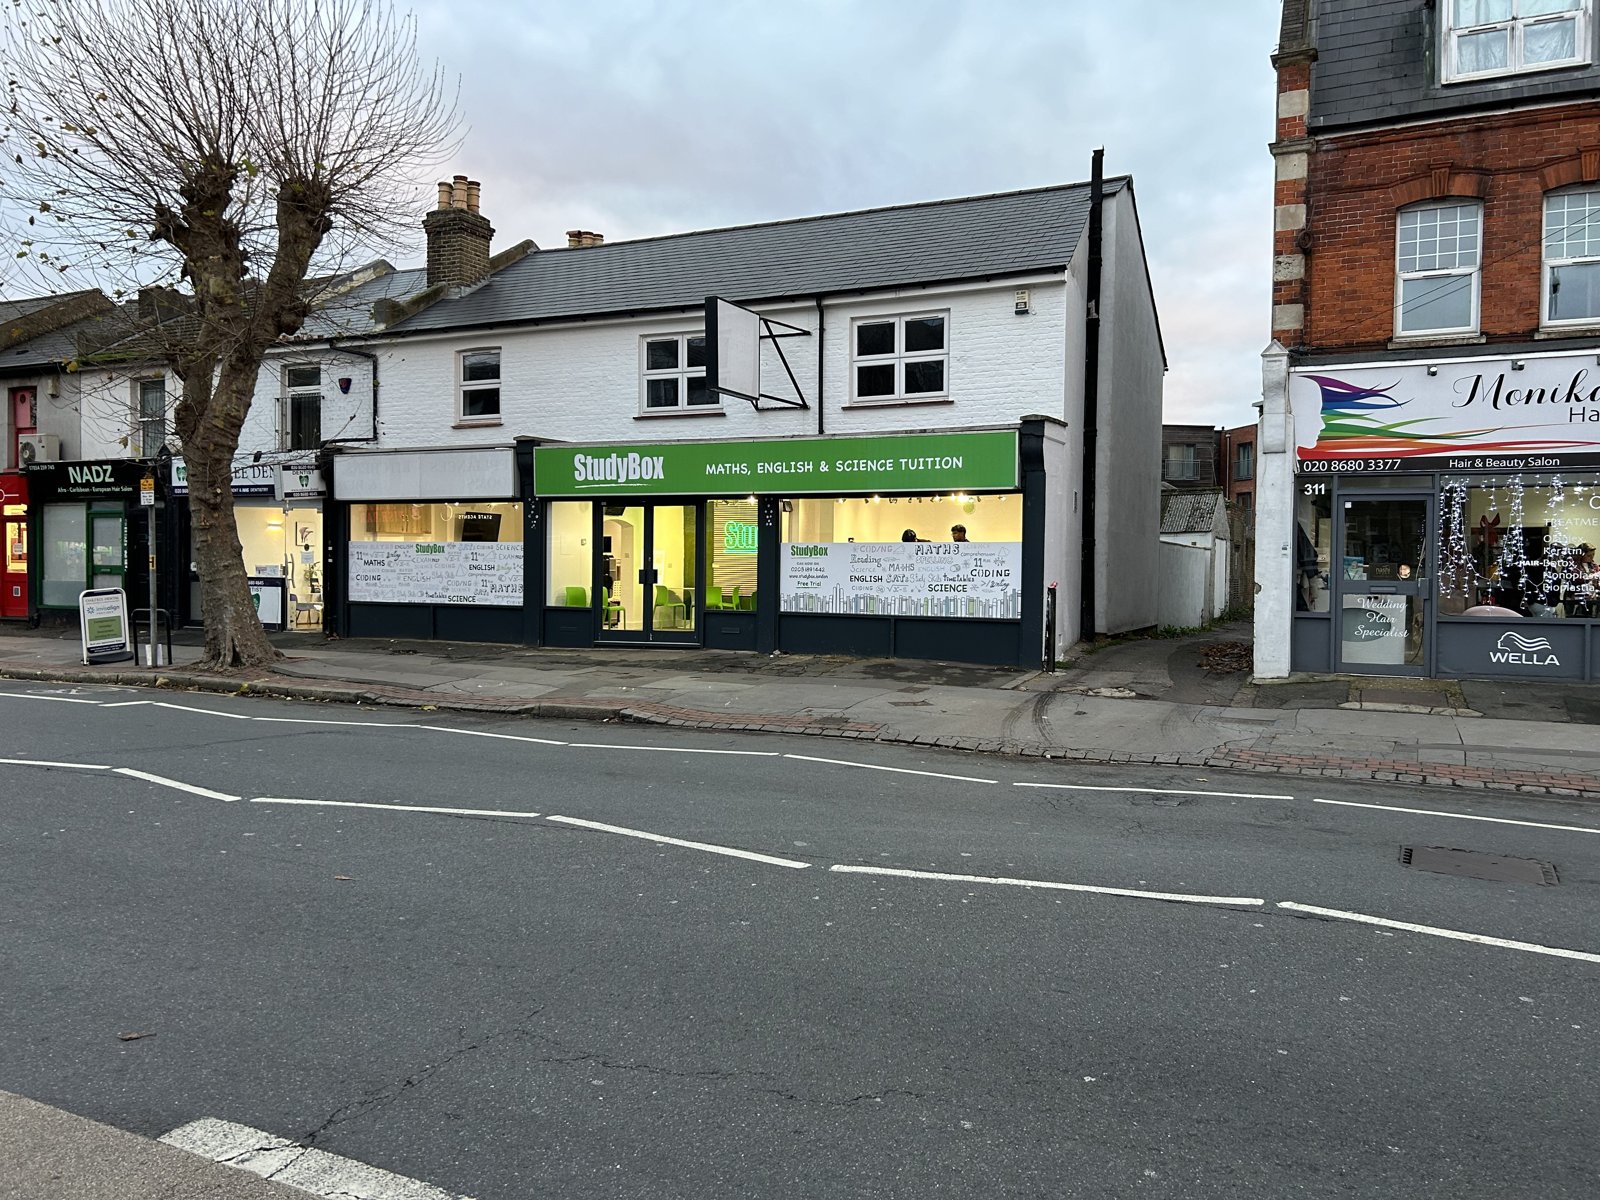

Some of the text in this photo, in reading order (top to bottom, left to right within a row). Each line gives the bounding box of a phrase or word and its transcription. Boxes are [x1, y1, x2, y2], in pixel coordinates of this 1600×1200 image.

[574, 452, 664, 482] StudyBox
[706, 456, 963, 475] MATHS, ENGLISH & SCIENCE TUITION
[1303, 459, 1401, 472] 020 8680 3377
[1450, 457, 1560, 469] Hair & Beauty Salon
[68, 465, 115, 484] NADZ
[1304, 483, 1325, 495] 311
[416, 544, 445, 555] StudyBox
[790, 545, 828, 557] StudyBox
[915, 543, 960, 555] MATHS
[849, 575, 883, 583] ENGLISH
[928, 584, 968, 593] SCIENCE
[447, 595, 476, 603] SCIENCE
[1358, 597, 1408, 612] Wedding
[1366, 612, 1396, 623] Hair
[1354, 624, 1409, 639] Specialist
[1489, 651, 1560, 666] WELLA
